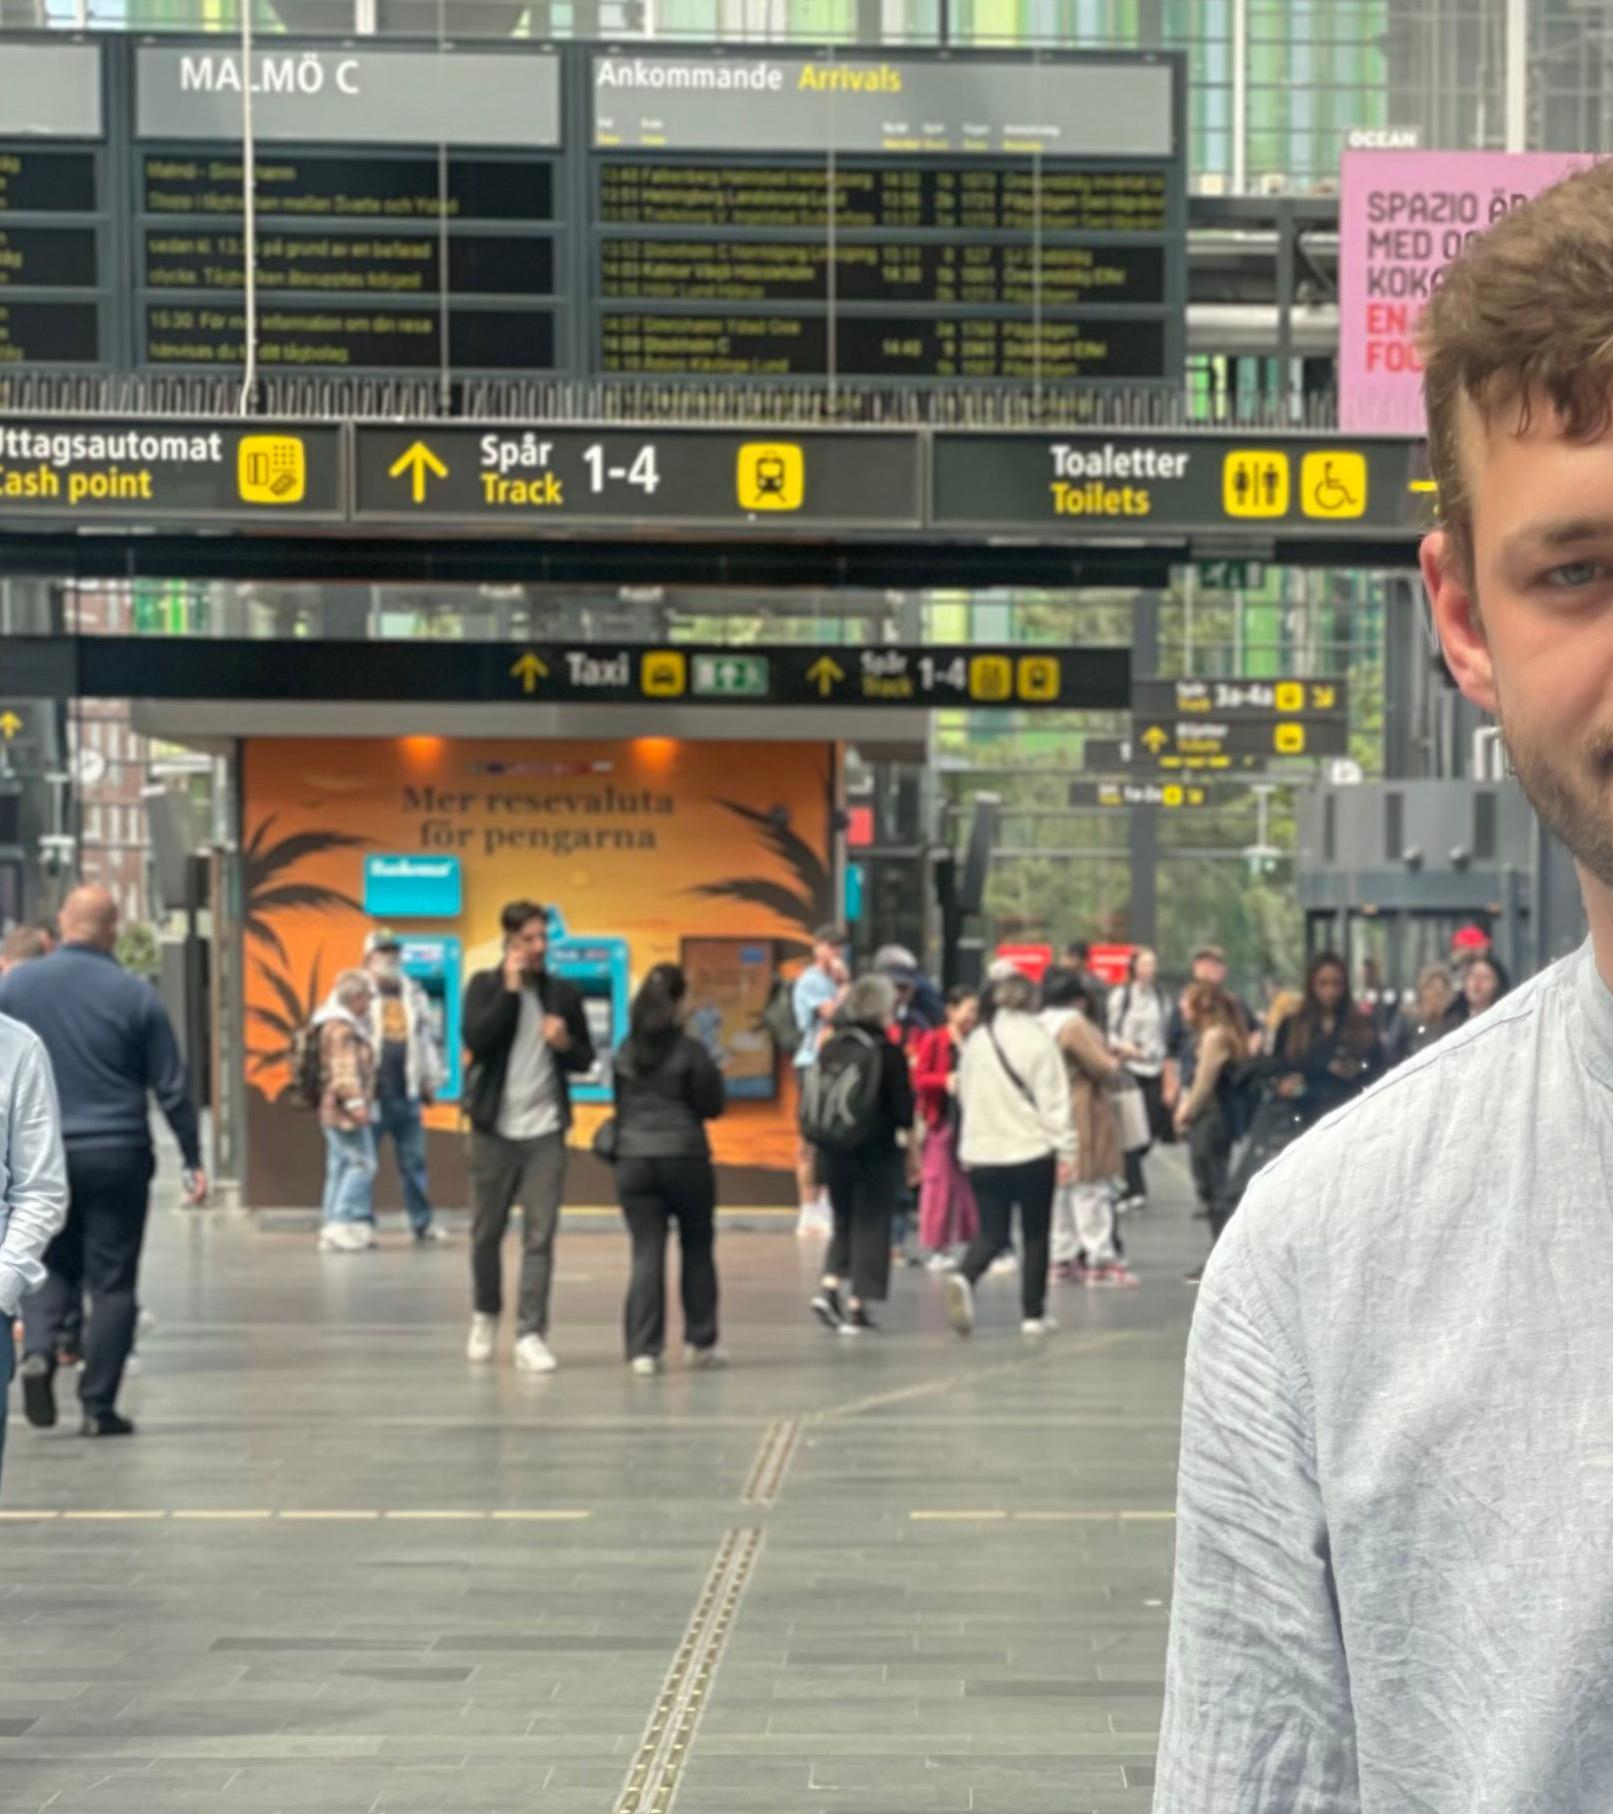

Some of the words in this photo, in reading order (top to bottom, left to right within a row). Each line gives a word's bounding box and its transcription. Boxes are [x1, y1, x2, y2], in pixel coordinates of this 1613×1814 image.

[336, 59, 360, 94] C
[598, 60, 783, 90] Ankommande
[798, 64, 902, 92] Arrivals
[1349, 131, 1416, 148] OCEAN
[1367, 192, 1478, 224] SPAZIO
[1367, 229, 1432, 260] MED
[1367, 303, 1407, 335] EN
[481, 433, 553, 474] Spår
[583, 443, 661, 493] 1-4
[1050, 444, 1189, 478] Toaletter
[0, 463, 58, 497] ash
[68, 465, 152, 504] point
[480, 471, 563, 505] Track
[1050, 481, 1151, 514] Toilets
[565, 652, 630, 686] Taxi
[919, 657, 966, 690] 1-4
[402, 785, 473, 814] Mer
[485, 783, 676, 815] resevaluta
[420, 820, 474, 848] för
[484, 827, 657, 855] pengarna
